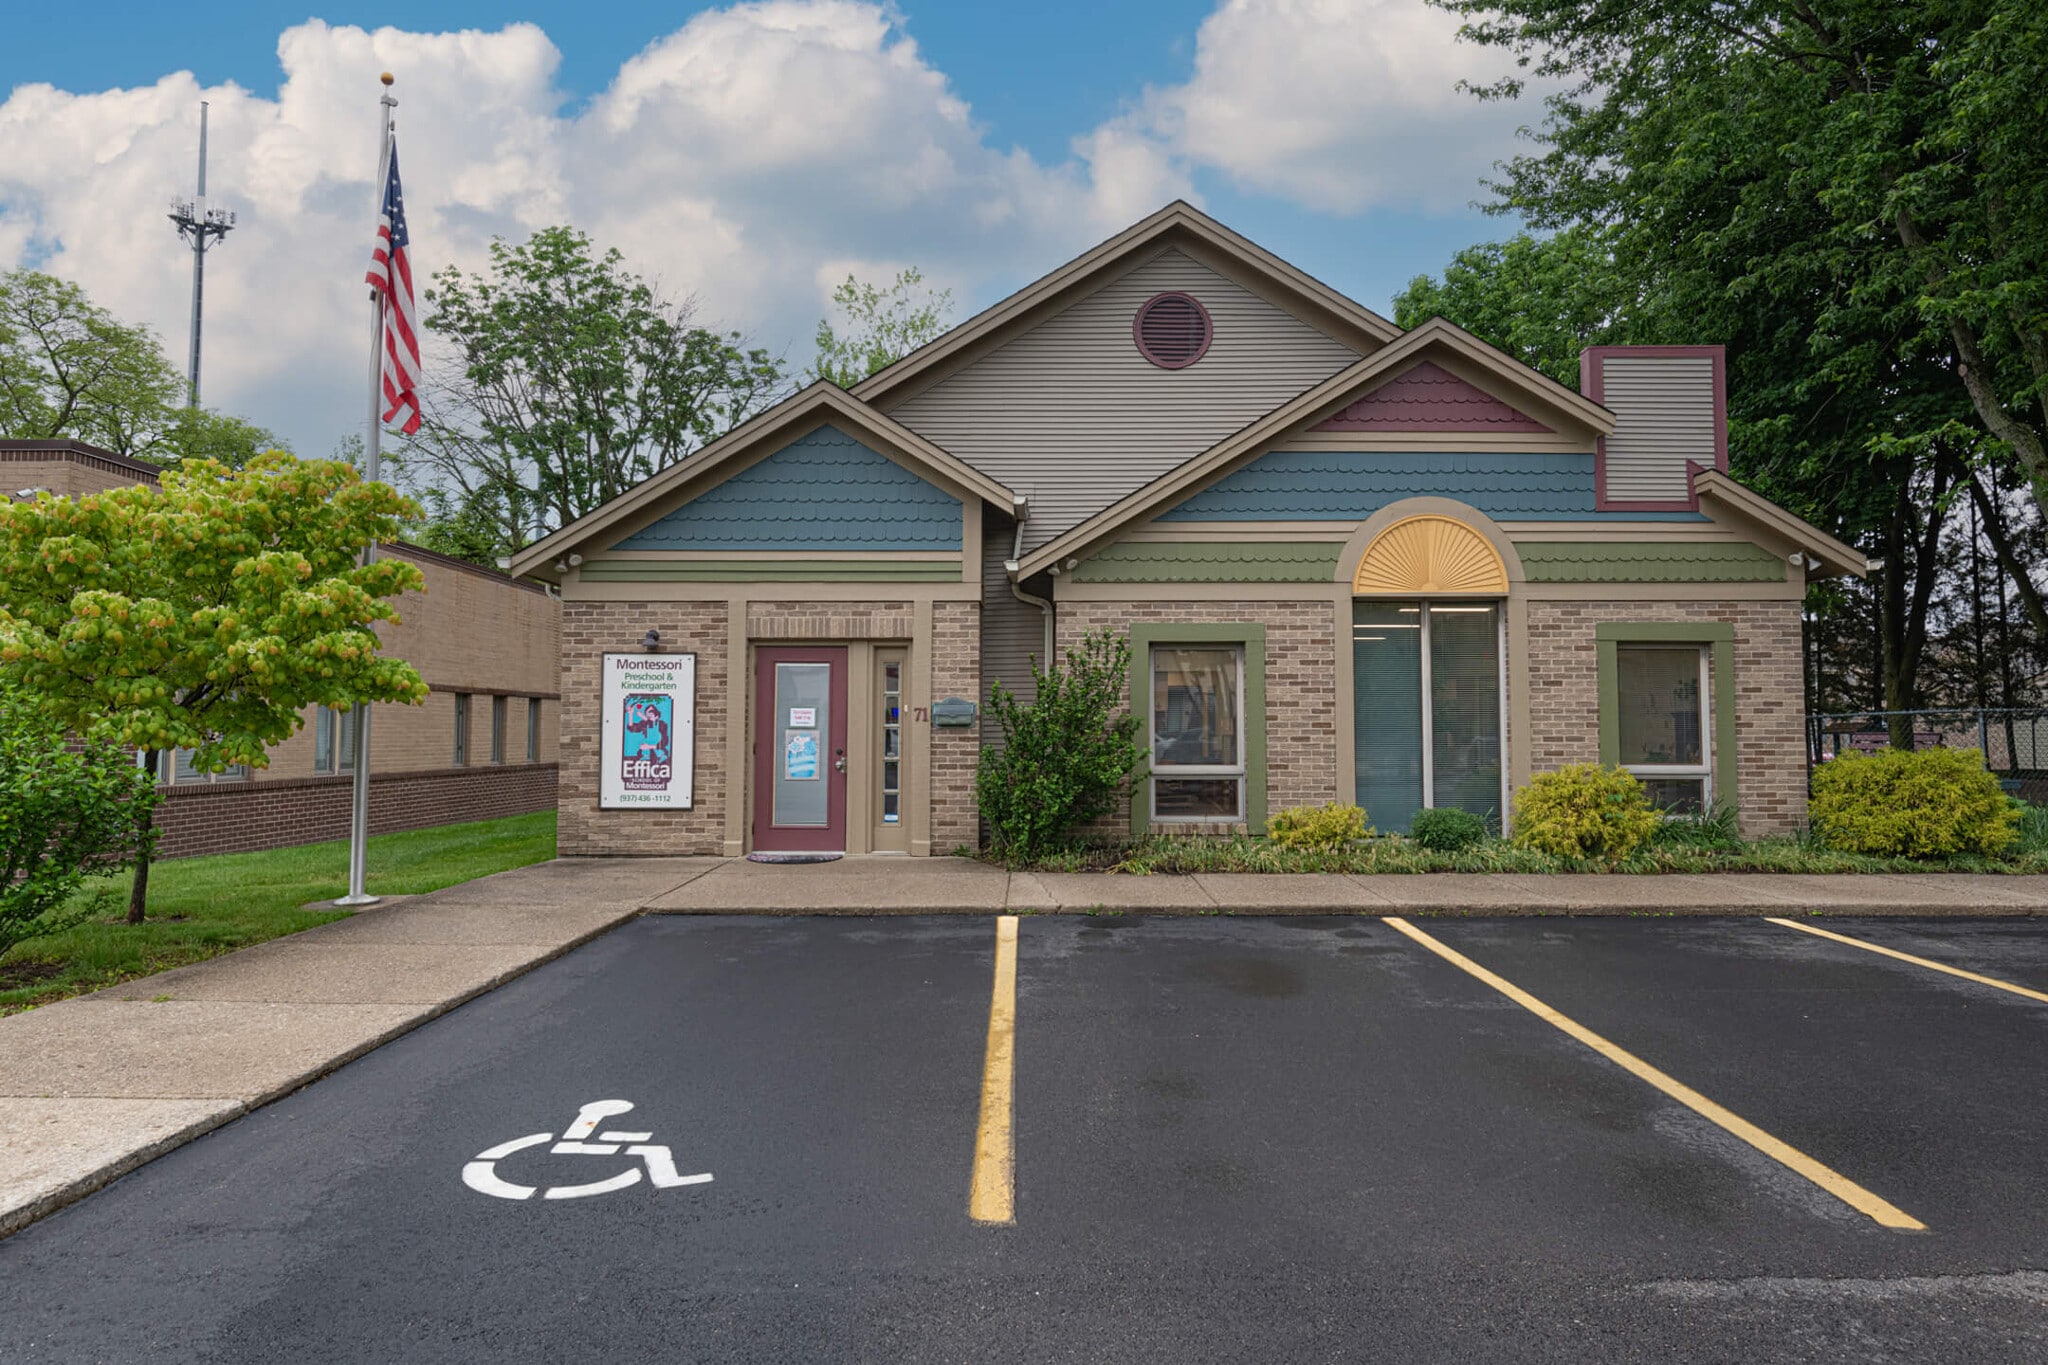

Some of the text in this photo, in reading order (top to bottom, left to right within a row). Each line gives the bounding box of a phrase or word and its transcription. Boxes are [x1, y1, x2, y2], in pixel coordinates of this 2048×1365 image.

[616, 659, 682, 670] Montessori
[624, 672, 673, 681] Preschool &
[621, 681, 677, 692] Kindergarten
[914, 707, 929, 723] 71
[622, 760, 670, 778] Effica
[625, 782, 665, 790] Montessori
